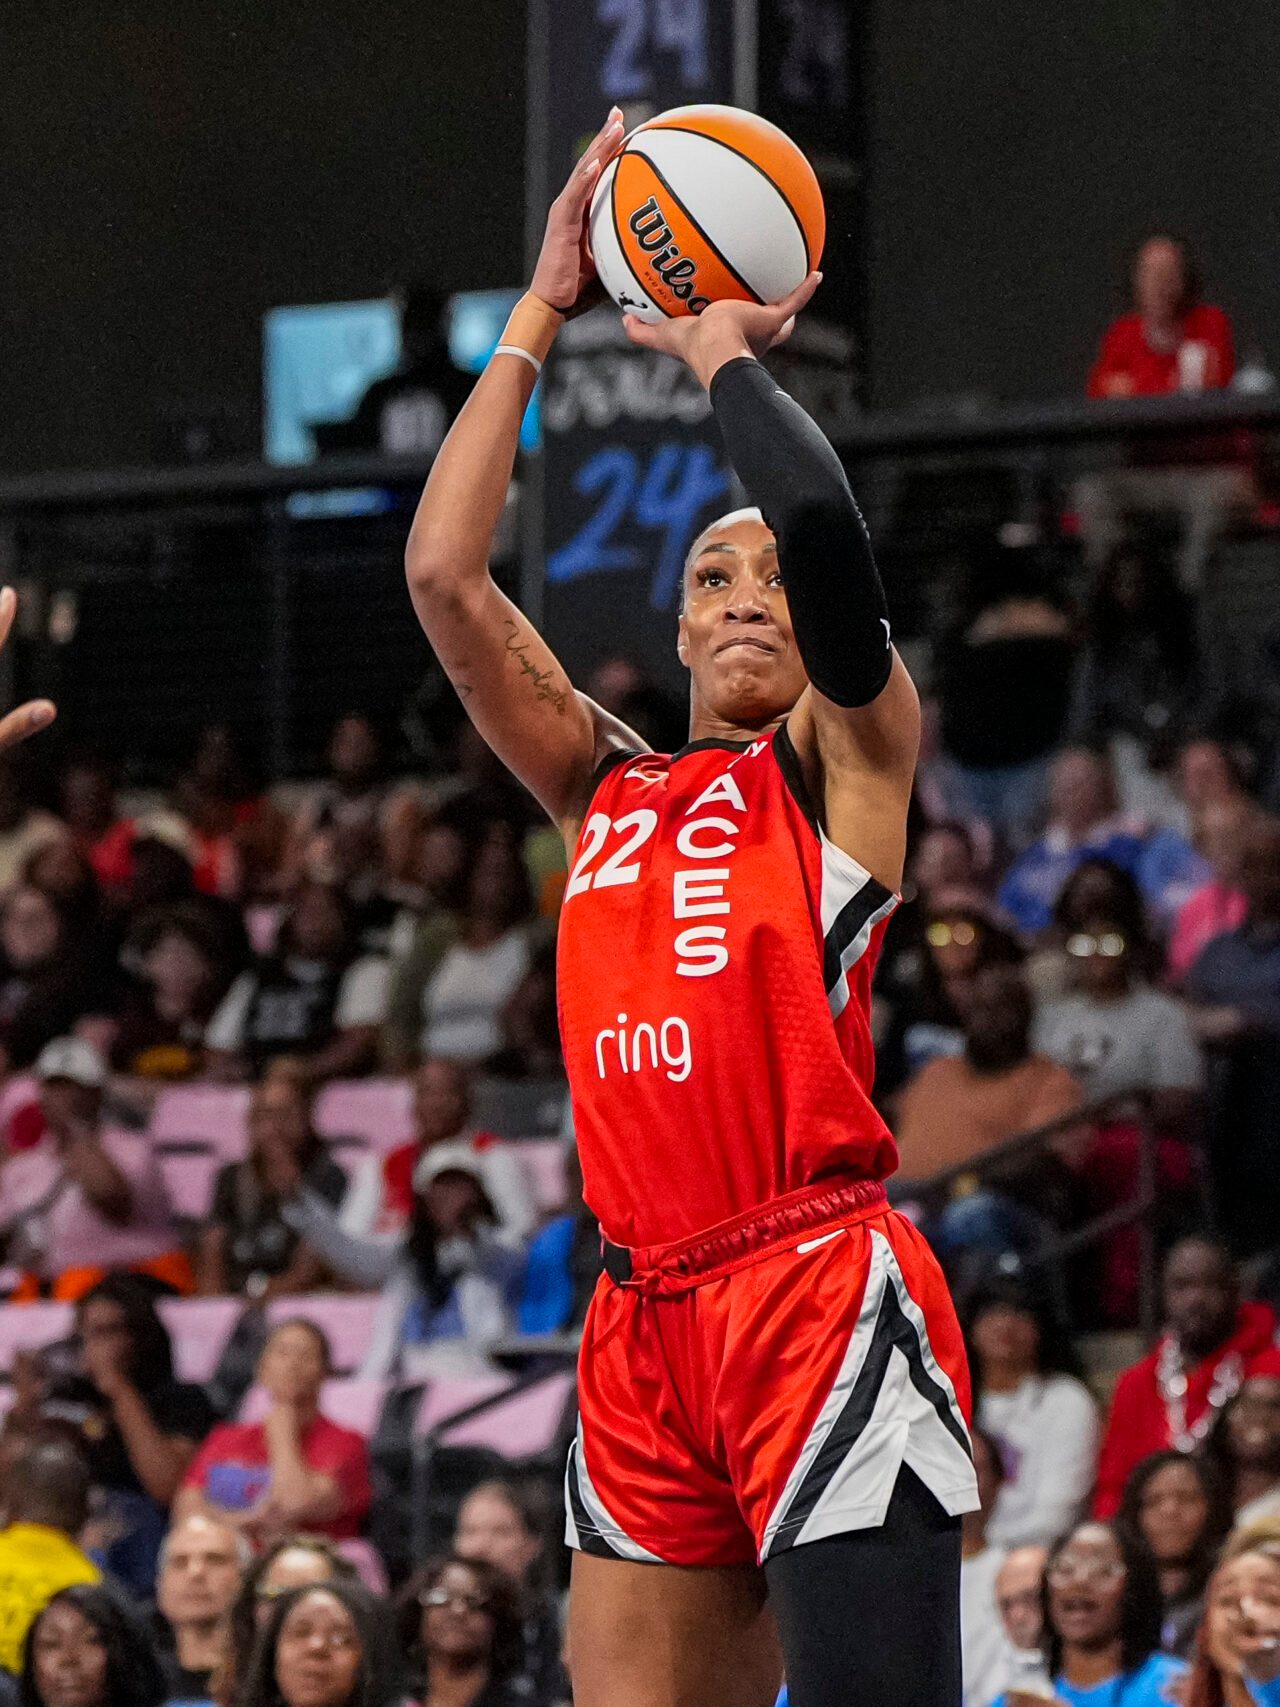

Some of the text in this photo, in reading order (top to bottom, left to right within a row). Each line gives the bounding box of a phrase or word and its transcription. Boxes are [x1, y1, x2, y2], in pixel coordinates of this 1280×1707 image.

[628, 194, 711, 315] Wilso
[546, 443, 729, 612] 24
[564, 808, 658, 904] 22
[673, 772, 748, 978] ACES
[595, 1012, 692, 1083] ring
